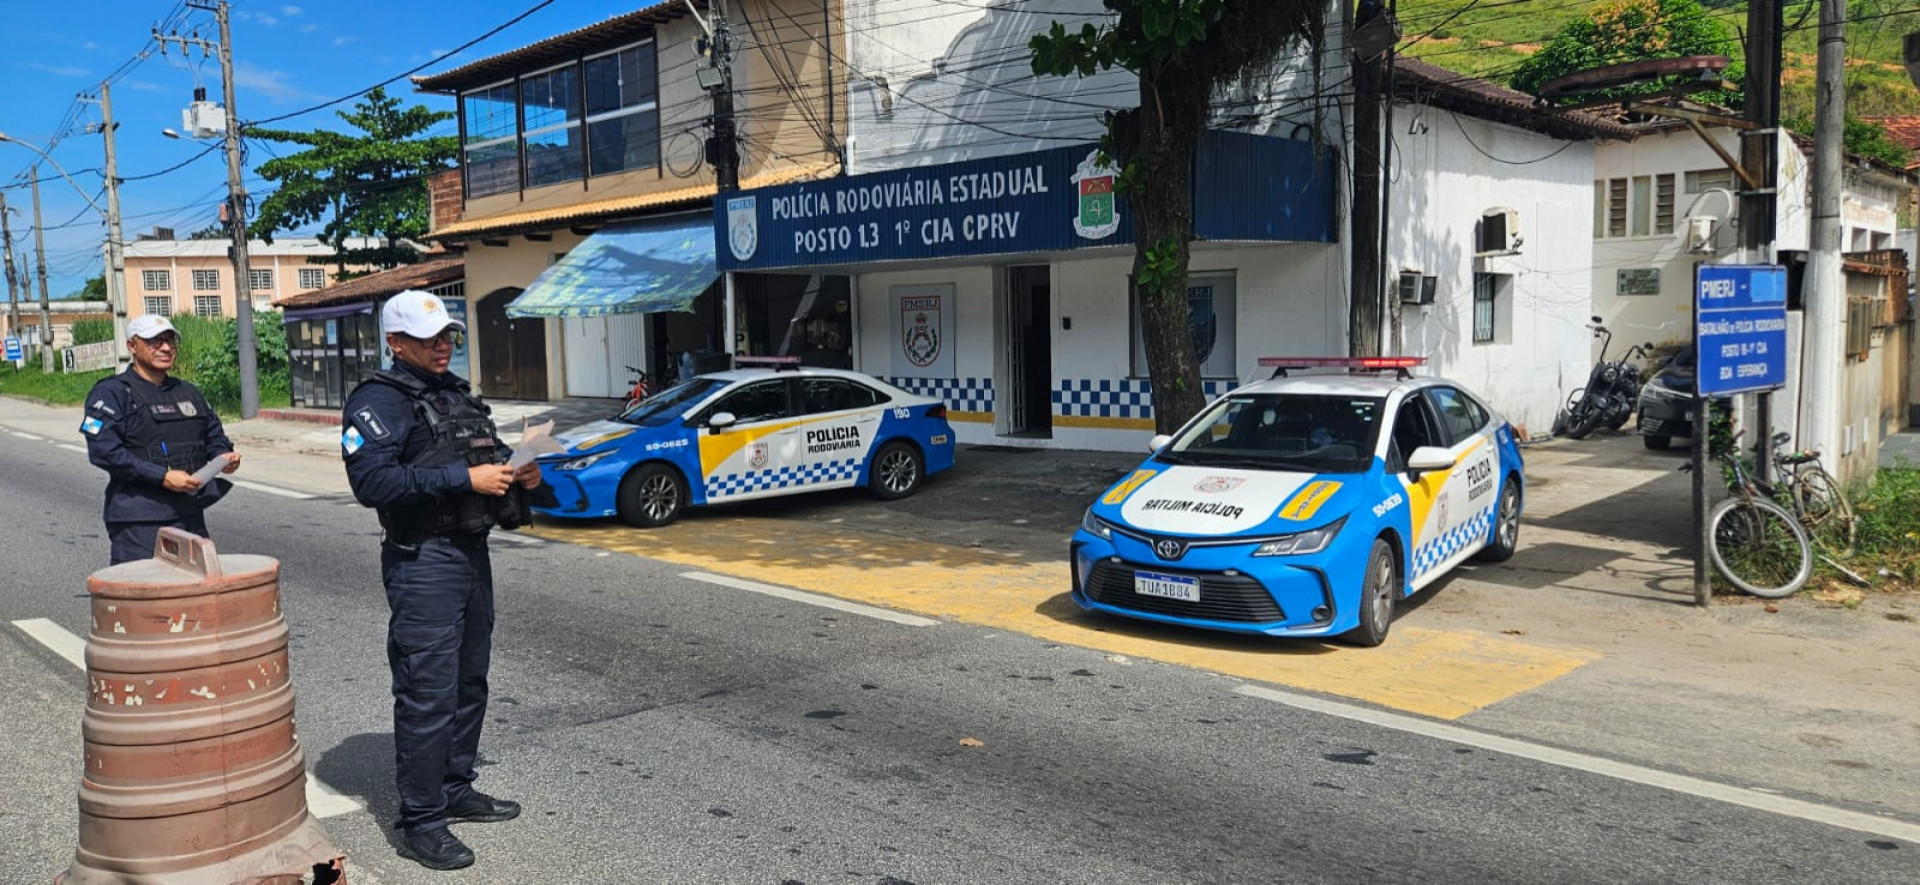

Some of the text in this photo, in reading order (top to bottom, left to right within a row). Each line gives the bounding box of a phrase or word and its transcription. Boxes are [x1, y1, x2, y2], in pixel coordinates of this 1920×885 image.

[772, 165, 1049, 220] POLÍCIA RODOVIÁRIA ESTADUAL
[794, 225, 852, 253] POSTO
[921, 217, 954, 245] CIA
[962, 211, 1021, 241] CPRV
[1701, 279, 1735, 299] PMERJ
[893, 408, 910, 420] 190
